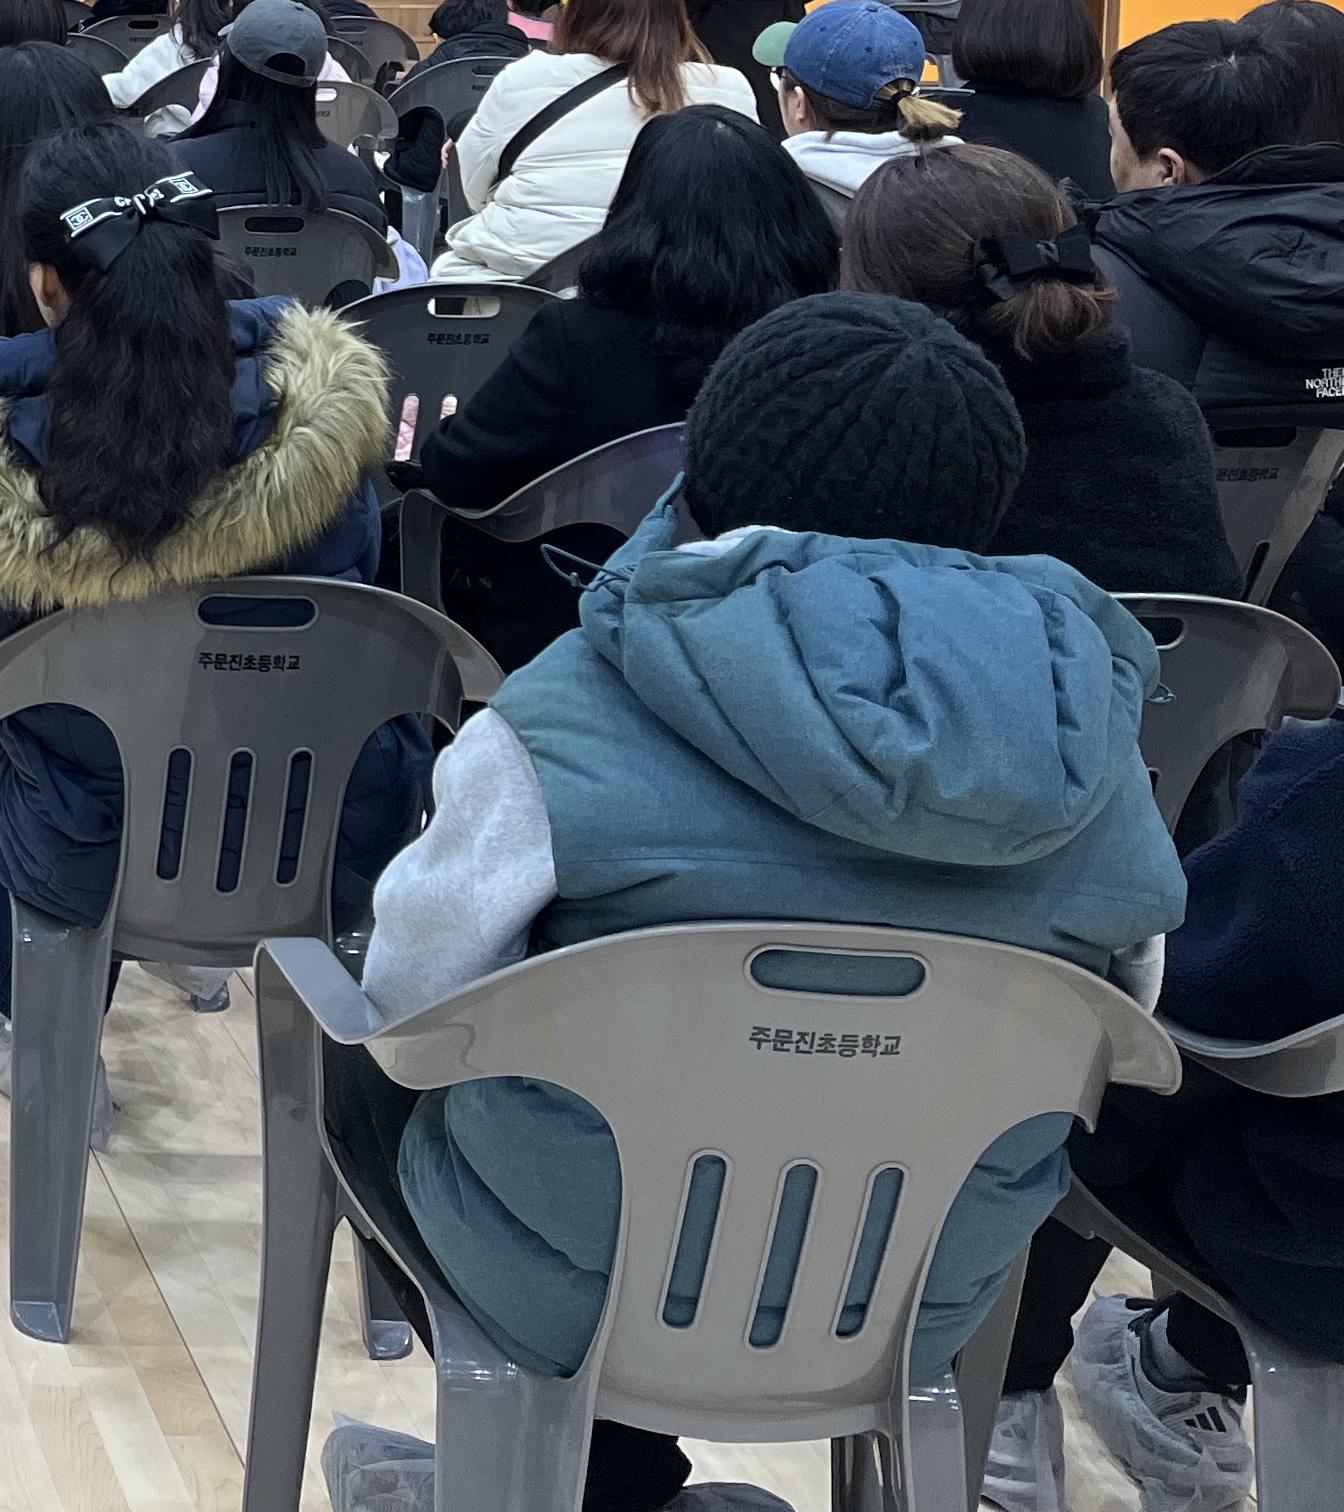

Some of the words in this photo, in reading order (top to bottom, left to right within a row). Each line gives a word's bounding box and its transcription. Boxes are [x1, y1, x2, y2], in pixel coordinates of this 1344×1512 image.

[245, 246, 297, 257] 주문진초등학교
[427, 333, 491, 345] 주문진초등학교
[1321, 367, 1343, 378] THE
[1316, 387, 1343, 398] FACE
[1216, 468, 1280, 481] 문진초등학교
[198, 652, 300, 673] 주문진초등학교
[749, 1026, 901, 1058] 주문진초등학교
